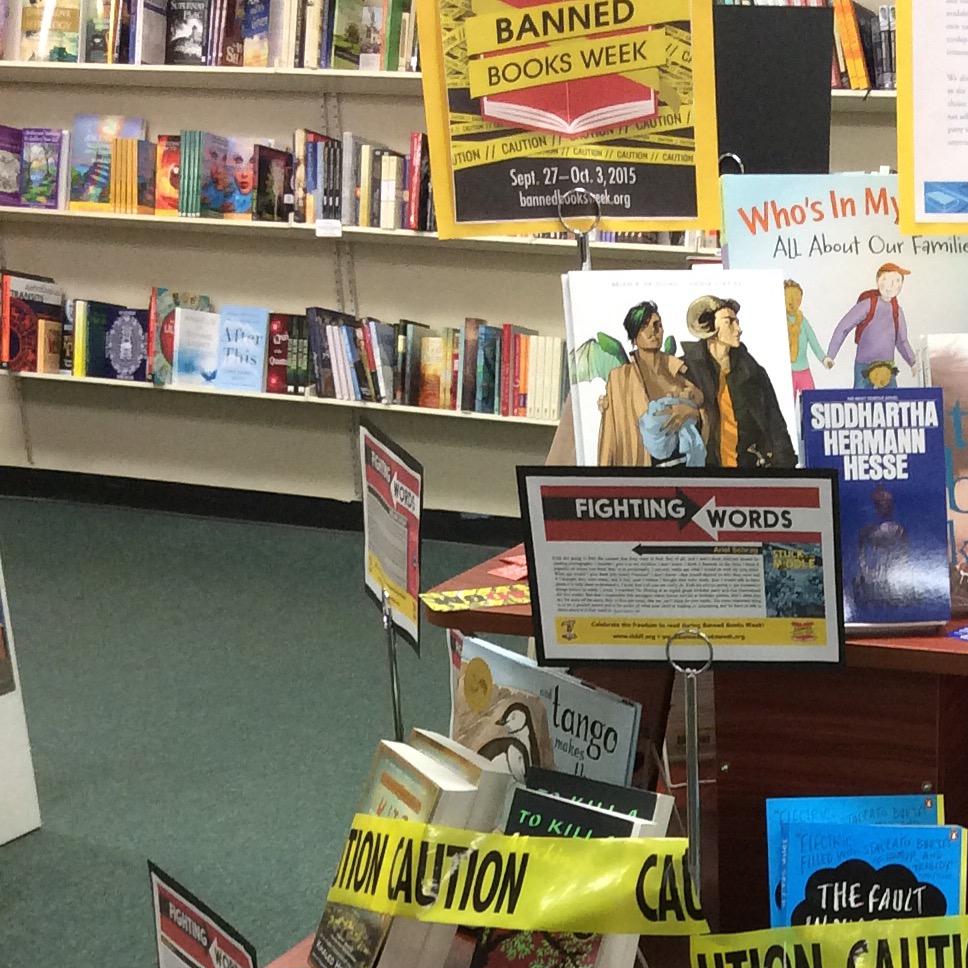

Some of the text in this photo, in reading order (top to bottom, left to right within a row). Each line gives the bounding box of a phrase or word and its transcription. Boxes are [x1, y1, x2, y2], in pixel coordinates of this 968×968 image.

[495, 0, 635, 45] BANNED
[487, 40, 648, 86] BOOKS WEEK
[500, 135, 548, 155] CAUTION
[616, 151, 648, 160] CAUTION
[662, 153, 694, 163] CAUTION
[509, 168, 540, 189] Sept.
[738, 197, 825, 236] Who's
[829, 190, 856, 219] In
[809, 233, 860, 256] About
[868, 235, 904, 255] Our
[224, 326, 263, 346] After
[223, 346, 258, 366] This
[810, 400, 939, 431] SIDDHARTHA
[823, 427, 926, 456] HERMANN
[843, 453, 909, 482] HESSE
[393, 480, 416, 512] WORDS
[574, 498, 686, 520] FIGHTING
[706, 509, 793, 530] WORDS
[552, 685, 619, 761] tango
[554, 738, 585, 760] makes
[517, 808, 593, 839] TO KILL
[387, 838, 530, 915] CAUTION
[817, 881, 927, 915] THE FAULT
[168, 902, 208, 947] FIGHTING
